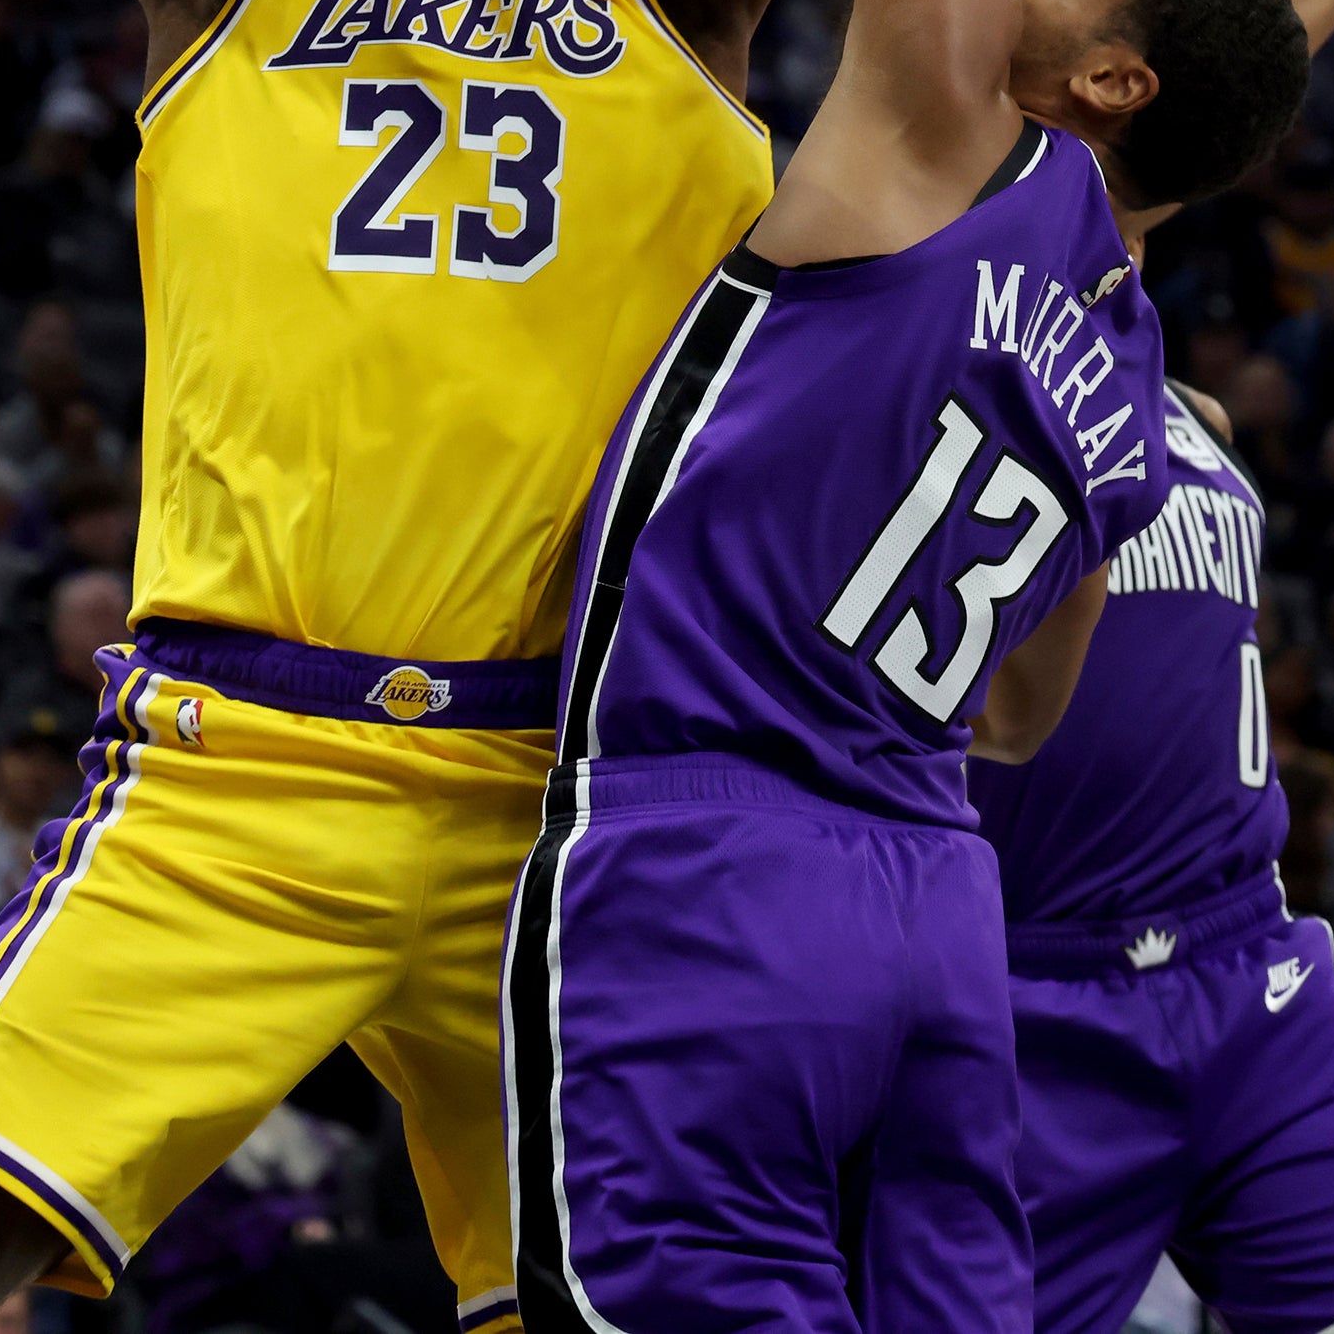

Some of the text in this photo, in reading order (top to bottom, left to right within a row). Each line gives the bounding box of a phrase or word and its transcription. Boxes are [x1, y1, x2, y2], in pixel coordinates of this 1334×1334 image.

[327, 78, 566, 284] 23
[969, 259, 1146, 498] MURRAY
[814, 389, 1069, 728] 13
[367, 677, 451, 712] LAKERS
[1238, 641, 1268, 789] 0
